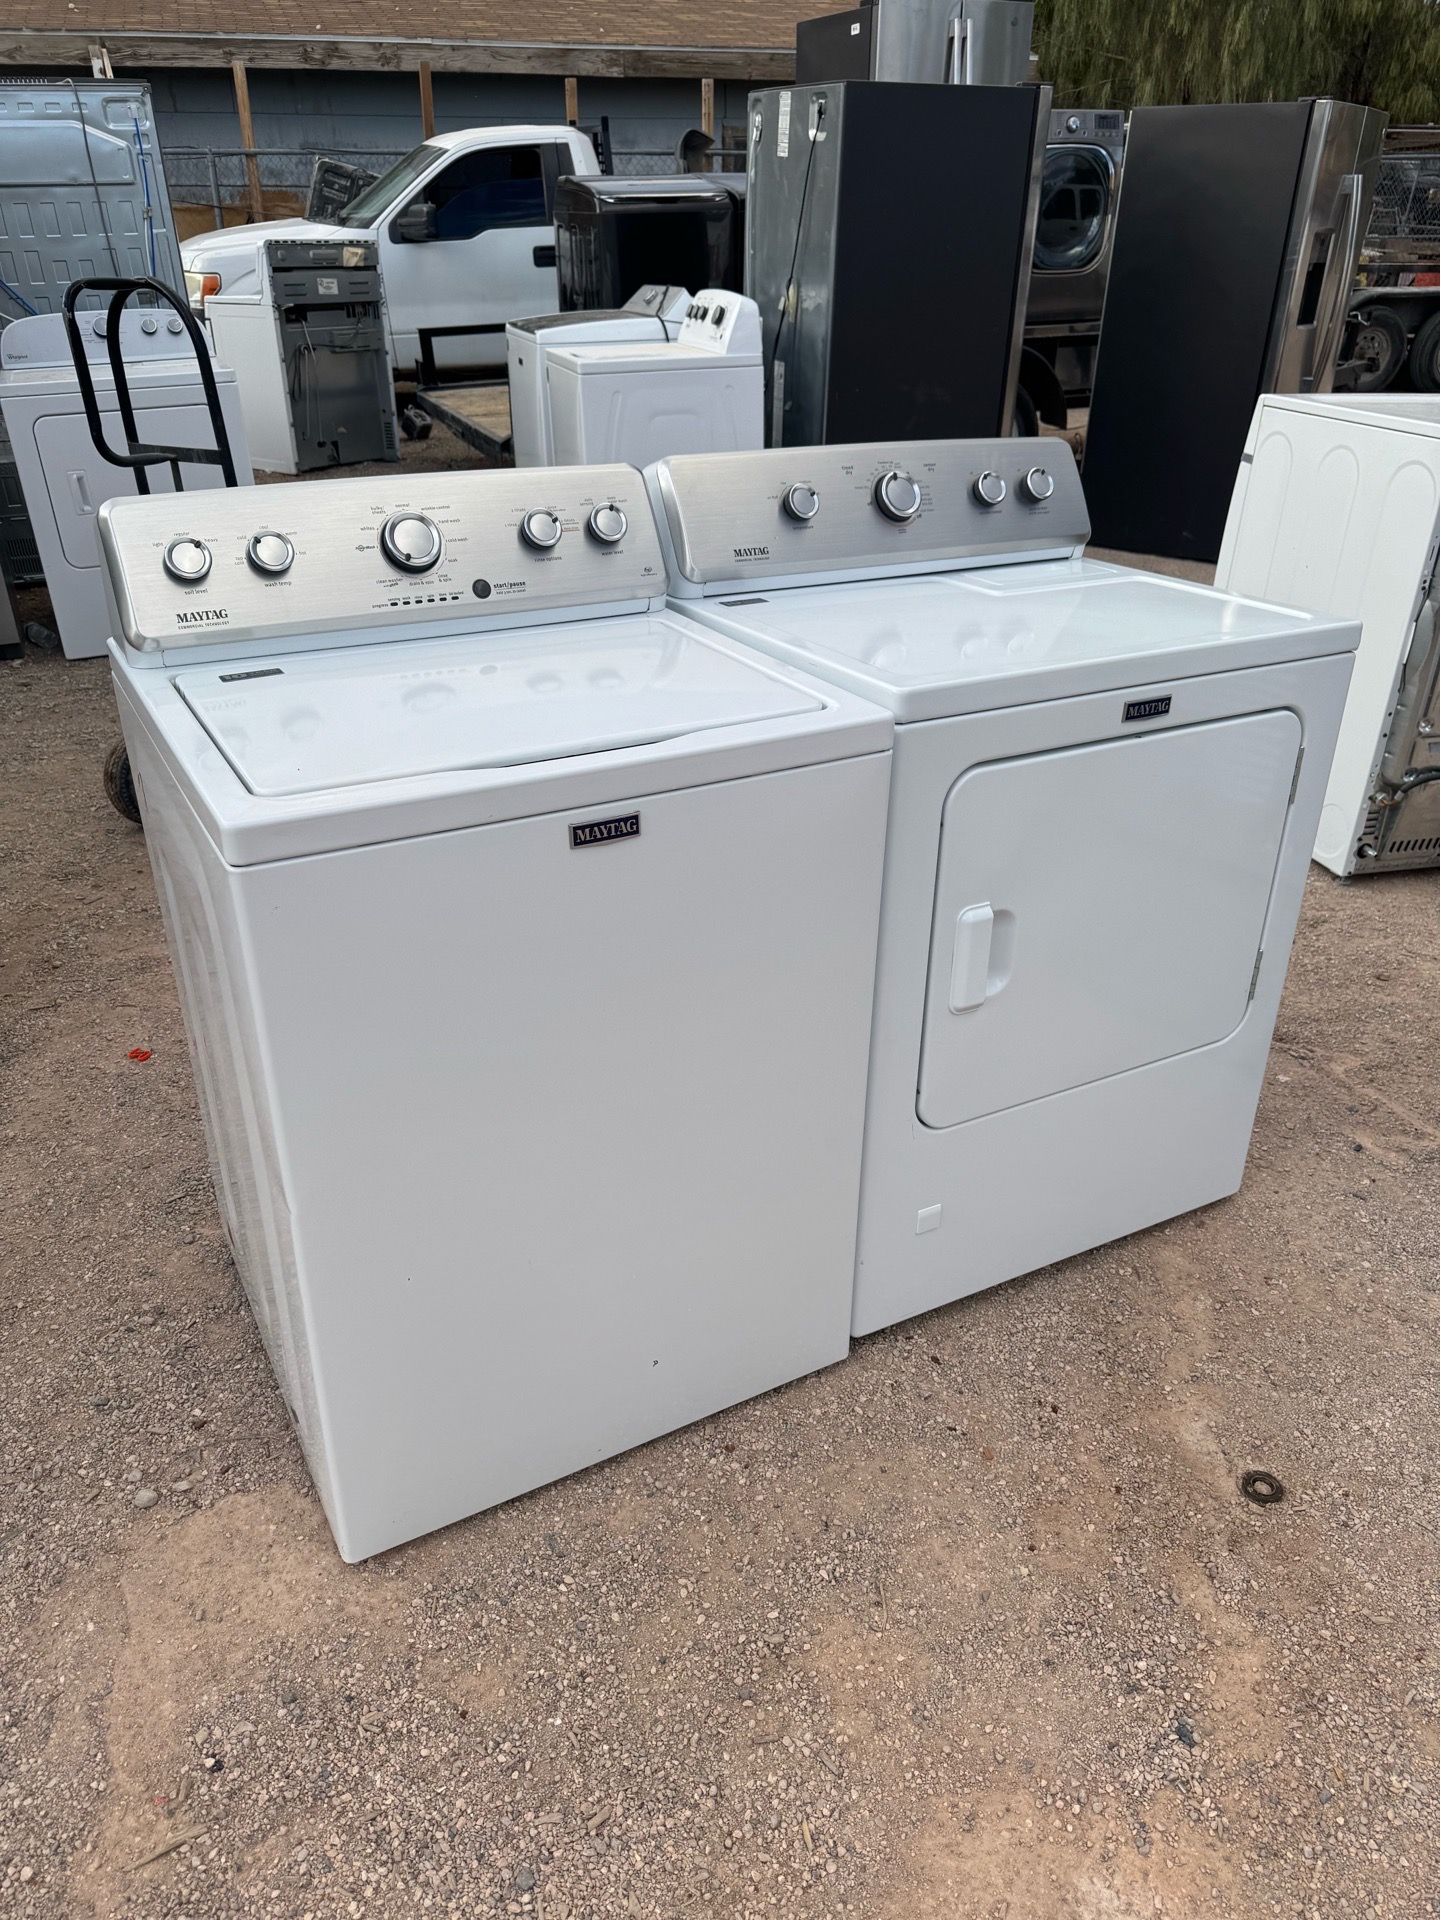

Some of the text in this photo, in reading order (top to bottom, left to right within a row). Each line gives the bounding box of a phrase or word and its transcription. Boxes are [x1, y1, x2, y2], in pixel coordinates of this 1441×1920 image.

[734, 546, 769, 558] MAYTAG
[176, 608, 228, 624] MAYTAG
[1128, 701, 1169, 718] MAYTAG
[575, 819, 638, 843] MAYTAG
